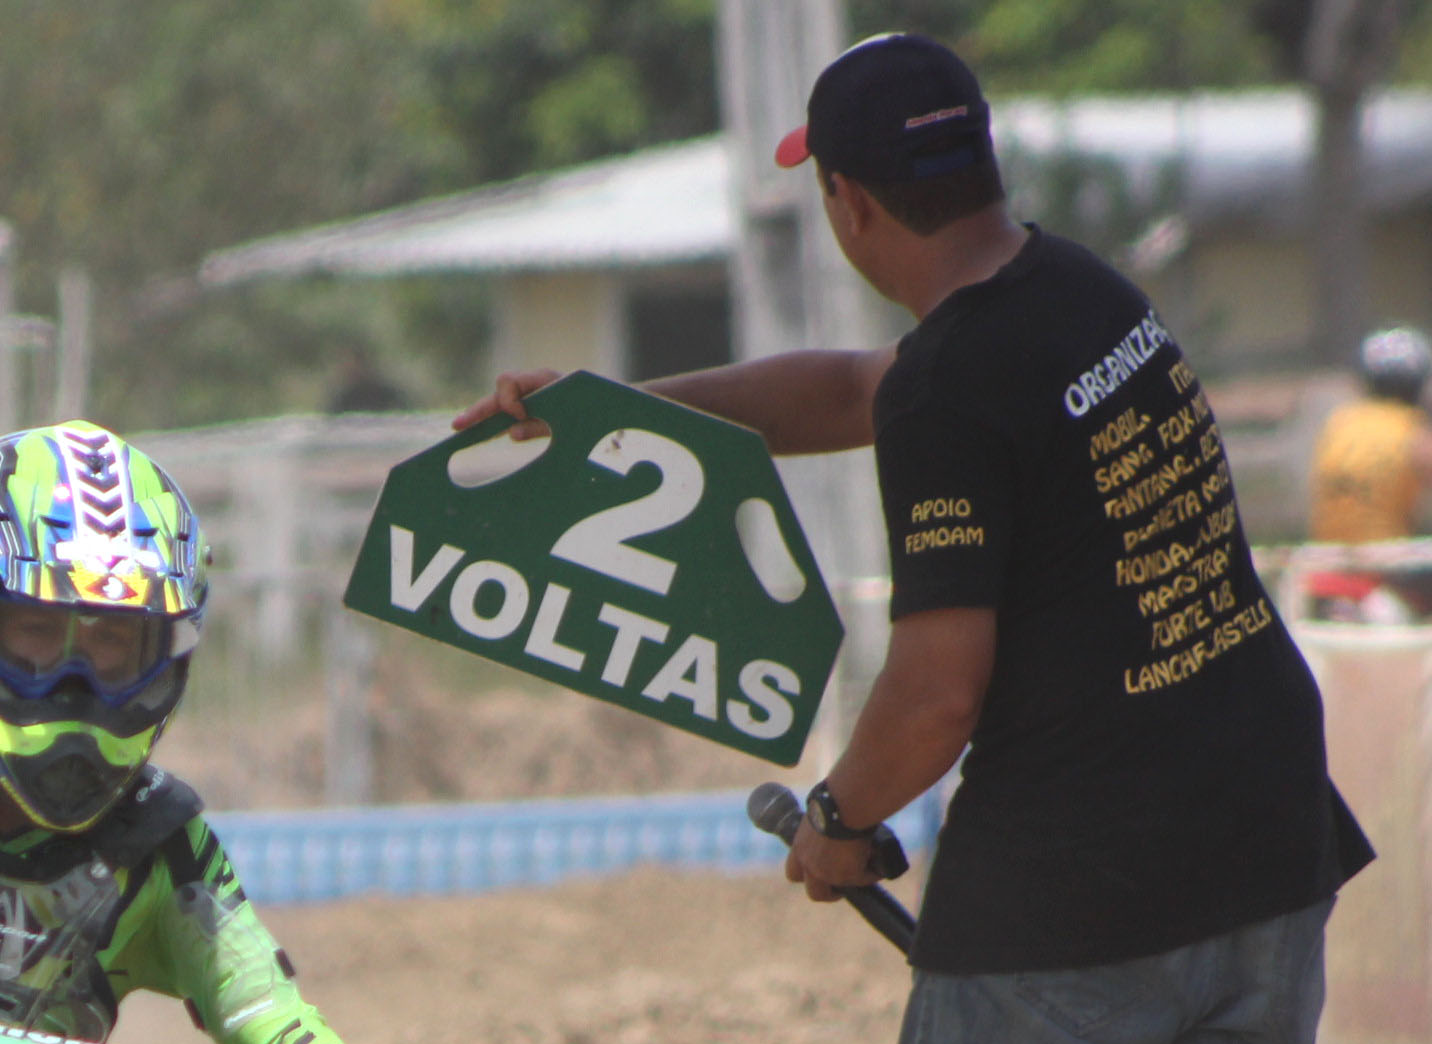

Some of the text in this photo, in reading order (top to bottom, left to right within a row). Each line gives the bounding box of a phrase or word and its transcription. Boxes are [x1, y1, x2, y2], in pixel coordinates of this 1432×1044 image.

[1157, 406, 1196, 449] FOX
[549, 428, 704, 596] 2
[911, 498, 971, 523] APOIO
[905, 526, 984, 555] FEMOAM
[389, 524, 801, 741] VOLTAS
